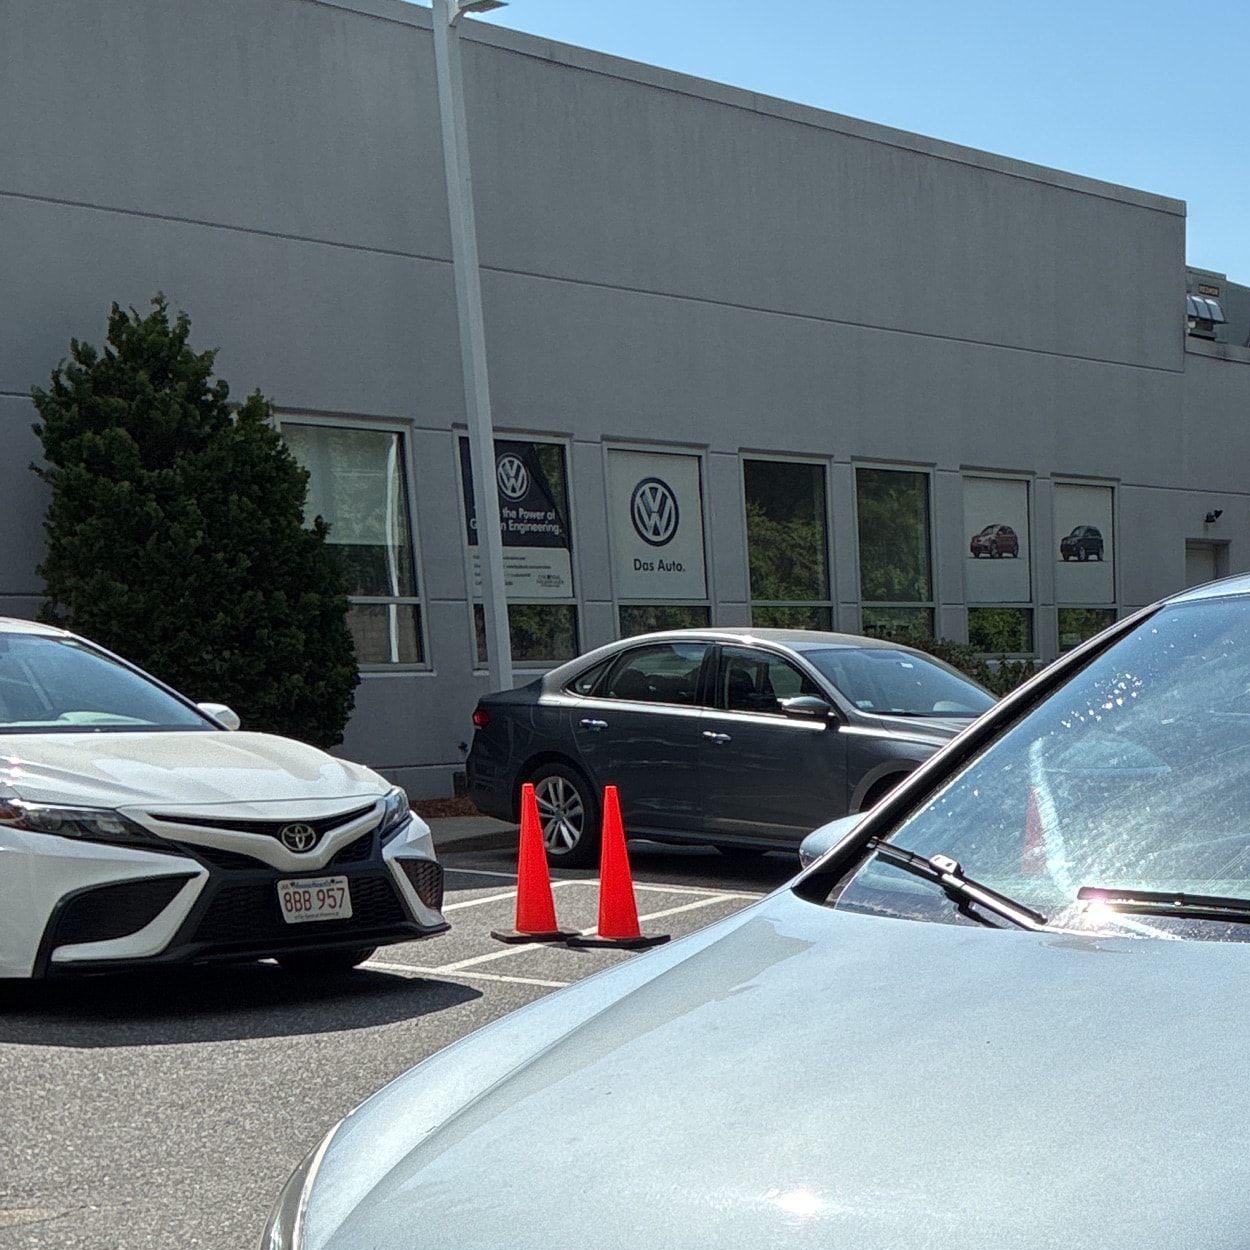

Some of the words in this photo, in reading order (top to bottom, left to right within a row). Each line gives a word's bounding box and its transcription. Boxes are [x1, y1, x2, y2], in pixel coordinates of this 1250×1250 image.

[519, 507, 545, 520] Power
[633, 480, 678, 544] VW
[509, 519, 562, 535] Engineering.
[633, 558, 655, 571] Das
[657, 559, 686, 572] Auto.
[283, 890, 312, 913] 8BB
[316, 887, 346, 911] 957
